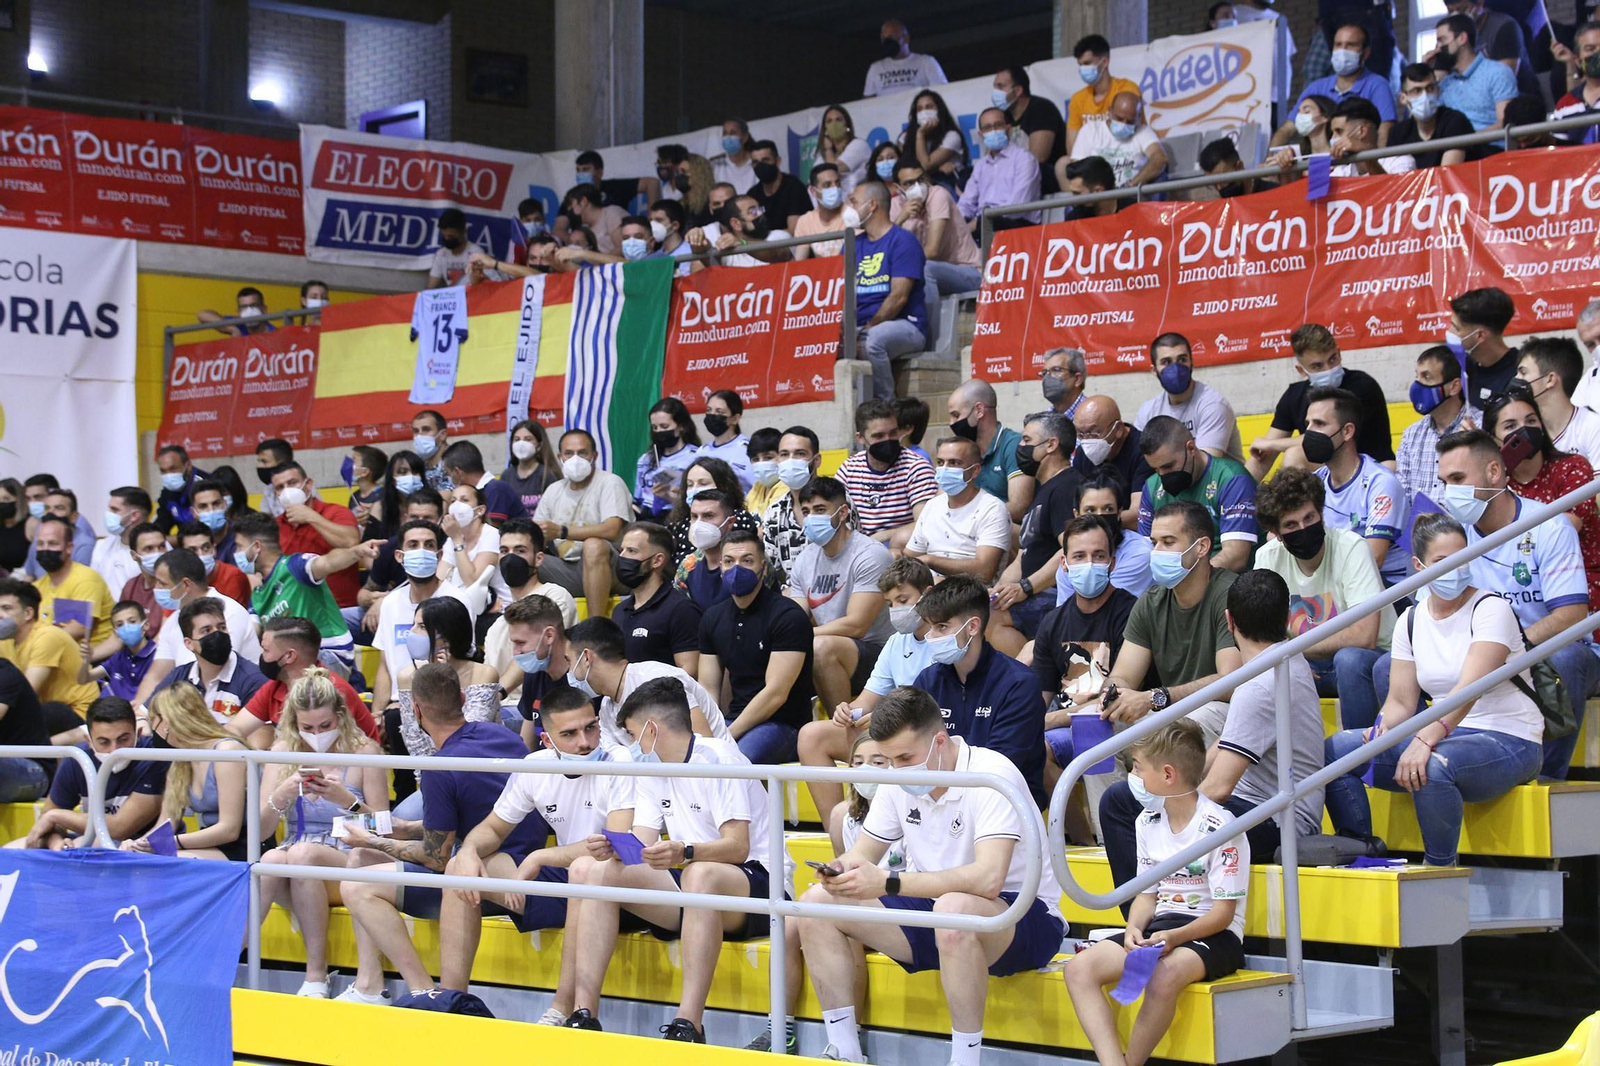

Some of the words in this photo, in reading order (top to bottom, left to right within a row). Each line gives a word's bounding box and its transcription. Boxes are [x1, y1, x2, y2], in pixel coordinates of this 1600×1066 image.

[879, 68, 919, 80] TOMMY
[1139, 43, 1242, 104] Angelo
[0, 156, 62, 171] ran.com
[72, 130, 182, 172] Durán
[77, 162, 186, 185] inmoduran.com
[195, 145, 298, 185] Durán
[325, 150, 498, 201] ELECTRO
[97, 189, 128, 202] EJIDO
[130, 192, 170, 207] FUTSAL
[200, 175, 300, 198] inmoduran.com
[218, 202, 248, 214] EJIDO
[249, 205, 288, 219] FUTSAL
[1325, 185, 1469, 244] Durán
[331, 208, 494, 257] MEDIA
[1179, 209, 1307, 263] Durán
[1044, 229, 1163, 279] Durán
[1325, 231, 1465, 266] inmoduran.com
[1177, 252, 1306, 284] inmoduran.com
[1503, 259, 1549, 278] EJIDO
[785, 274, 845, 312] Dur
[976, 286, 1025, 304] n.com
[1039, 272, 1160, 298] inmoduran.com
[1340, 279, 1381, 297] EJIDO
[1382, 271, 1433, 292] FUTSAL
[0, 296, 119, 339] RIAS
[430, 301, 457, 313] FRANCO
[681, 283, 775, 327] Durán
[1192, 300, 1230, 316] EJIDO
[1231, 293, 1278, 311] FUTSAL
[517, 284, 535, 363] EJIDO
[677, 318, 771, 345] inmoduran.com
[783, 309, 843, 330] inmodura
[1053, 313, 1089, 328] EJIDO
[1089, 310, 1134, 326] FUTSAL
[433, 313, 455, 354] 13
[244, 344, 314, 380] Durán
[686, 356, 714, 371] EJIDO
[714, 352, 749, 369] FUTSAL
[793, 344, 823, 358] EJIDO
[171, 352, 238, 386] Durán
[170, 384, 233, 401] inmoduran.com
[510, 372, 525, 405] EL
[811, 573, 840, 594] NIKE
[0, 1044, 20, 1066] al
[21, 1047, 41, 1066] de
